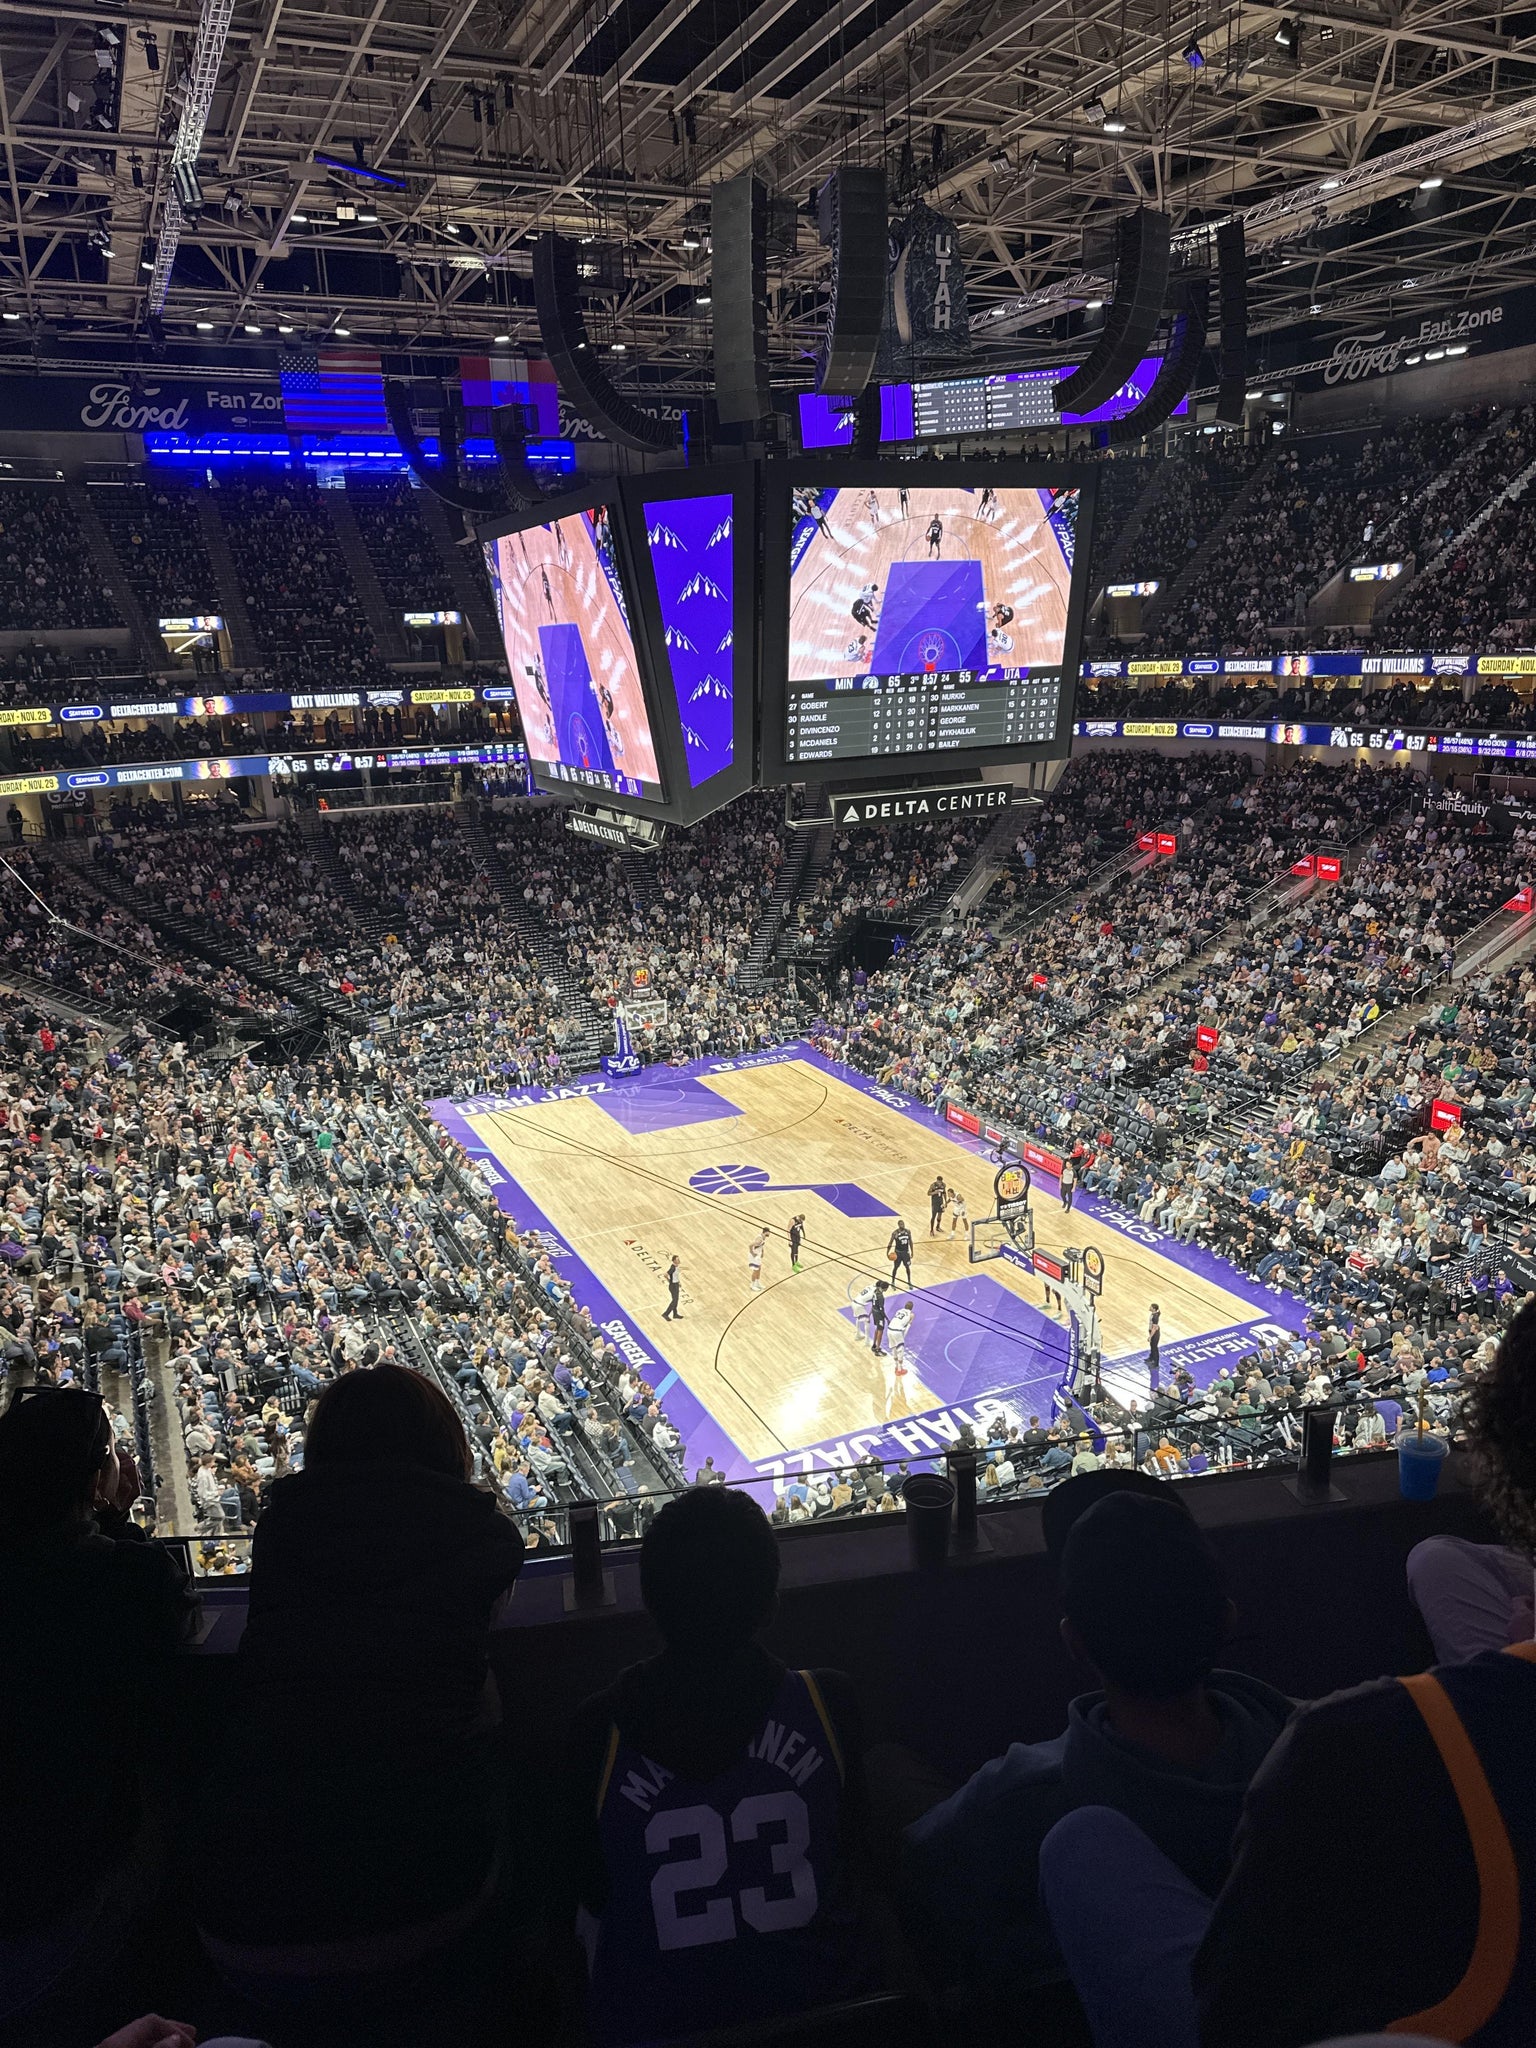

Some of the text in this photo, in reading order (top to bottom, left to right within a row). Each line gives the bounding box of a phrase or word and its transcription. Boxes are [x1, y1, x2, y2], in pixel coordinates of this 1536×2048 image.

[934, 234, 952, 330] UTAH
[1324, 306, 1503, 385] Ford Fan Zone
[80, 383, 284, 429] Ford Fan Zo
[1058, 531, 1074, 565] PAC
[1130, 663, 1156, 673] SATURDAY
[1160, 663, 1172, 672] NOV.
[1172, 663, 1180, 672] 29
[1224, 660, 1273, 672] DELTACENTER.COM
[1361, 658, 1382, 673] KATT
[1382, 657, 1424, 674] WILLIAMS
[1481, 660, 1514, 671] SATURDAY
[923, 674, 938, 684] 8:57
[942, 674, 950, 682] 24
[959, 672, 971, 683] 55
[1004, 668, 1020, 680] UTA
[835, 678, 853, 690] MIN
[888, 676, 900, 687] 65
[291, 694, 312, 708] KATT
[314, 692, 360, 707] WILLIAMS
[414, 689, 472, 701] SATURDAY NOV. 29
[942, 692, 966, 700] NURKIC
[110, 702, 178, 718] DELTACENTER.COM
[801, 702, 828, 710] GOBERT
[941, 704, 979, 712] MARKKANEN
[21, 711, 38, 722] NOV.
[38, 710, 48, 720] 29
[800, 714, 827, 722] RANDLE
[940, 716, 966, 724] GEORGE
[800, 726, 840, 735] DIVINCENZO
[1126, 724, 1175, 734] SATURDAY NOV. 29
[800, 738, 838, 748] MCDANIELS
[938, 740, 960, 748] BAILEY
[1350, 733, 1364, 746] 65
[1370, 734, 1382, 748] 55
[1407, 736, 1424, 750] 8:57
[800, 751, 832, 759] EDWARDS
[292, 760, 308, 772] 65
[314, 758, 329, 770] 55
[117, 766, 183, 783] DELTACENTER.COM
[30, 780, 44, 790] NOV.
[45, 779, 54, 789] 29
[865, 791, 1007, 819] DELTA CENTER
[578, 820, 626, 844] DELTA CENTER
[455, 1082, 613, 1117] UTAH JAZZ
[873, 1087, 911, 1108] PACS
[1101, 1211, 1164, 1244] PACS
[631, 1245, 662, 1272] DELTA
[601, 1319, 656, 1370] SEATGEEK
[1162, 1332, 1240, 1358] UNIVERSITY OF UTAH
[1170, 1336, 1257, 1368] HEALTH
[755, 1399, 1024, 1497] UTAH JAZZ
[620, 1719, 824, 1812] MANEN
[644, 1790, 818, 1950] 23
